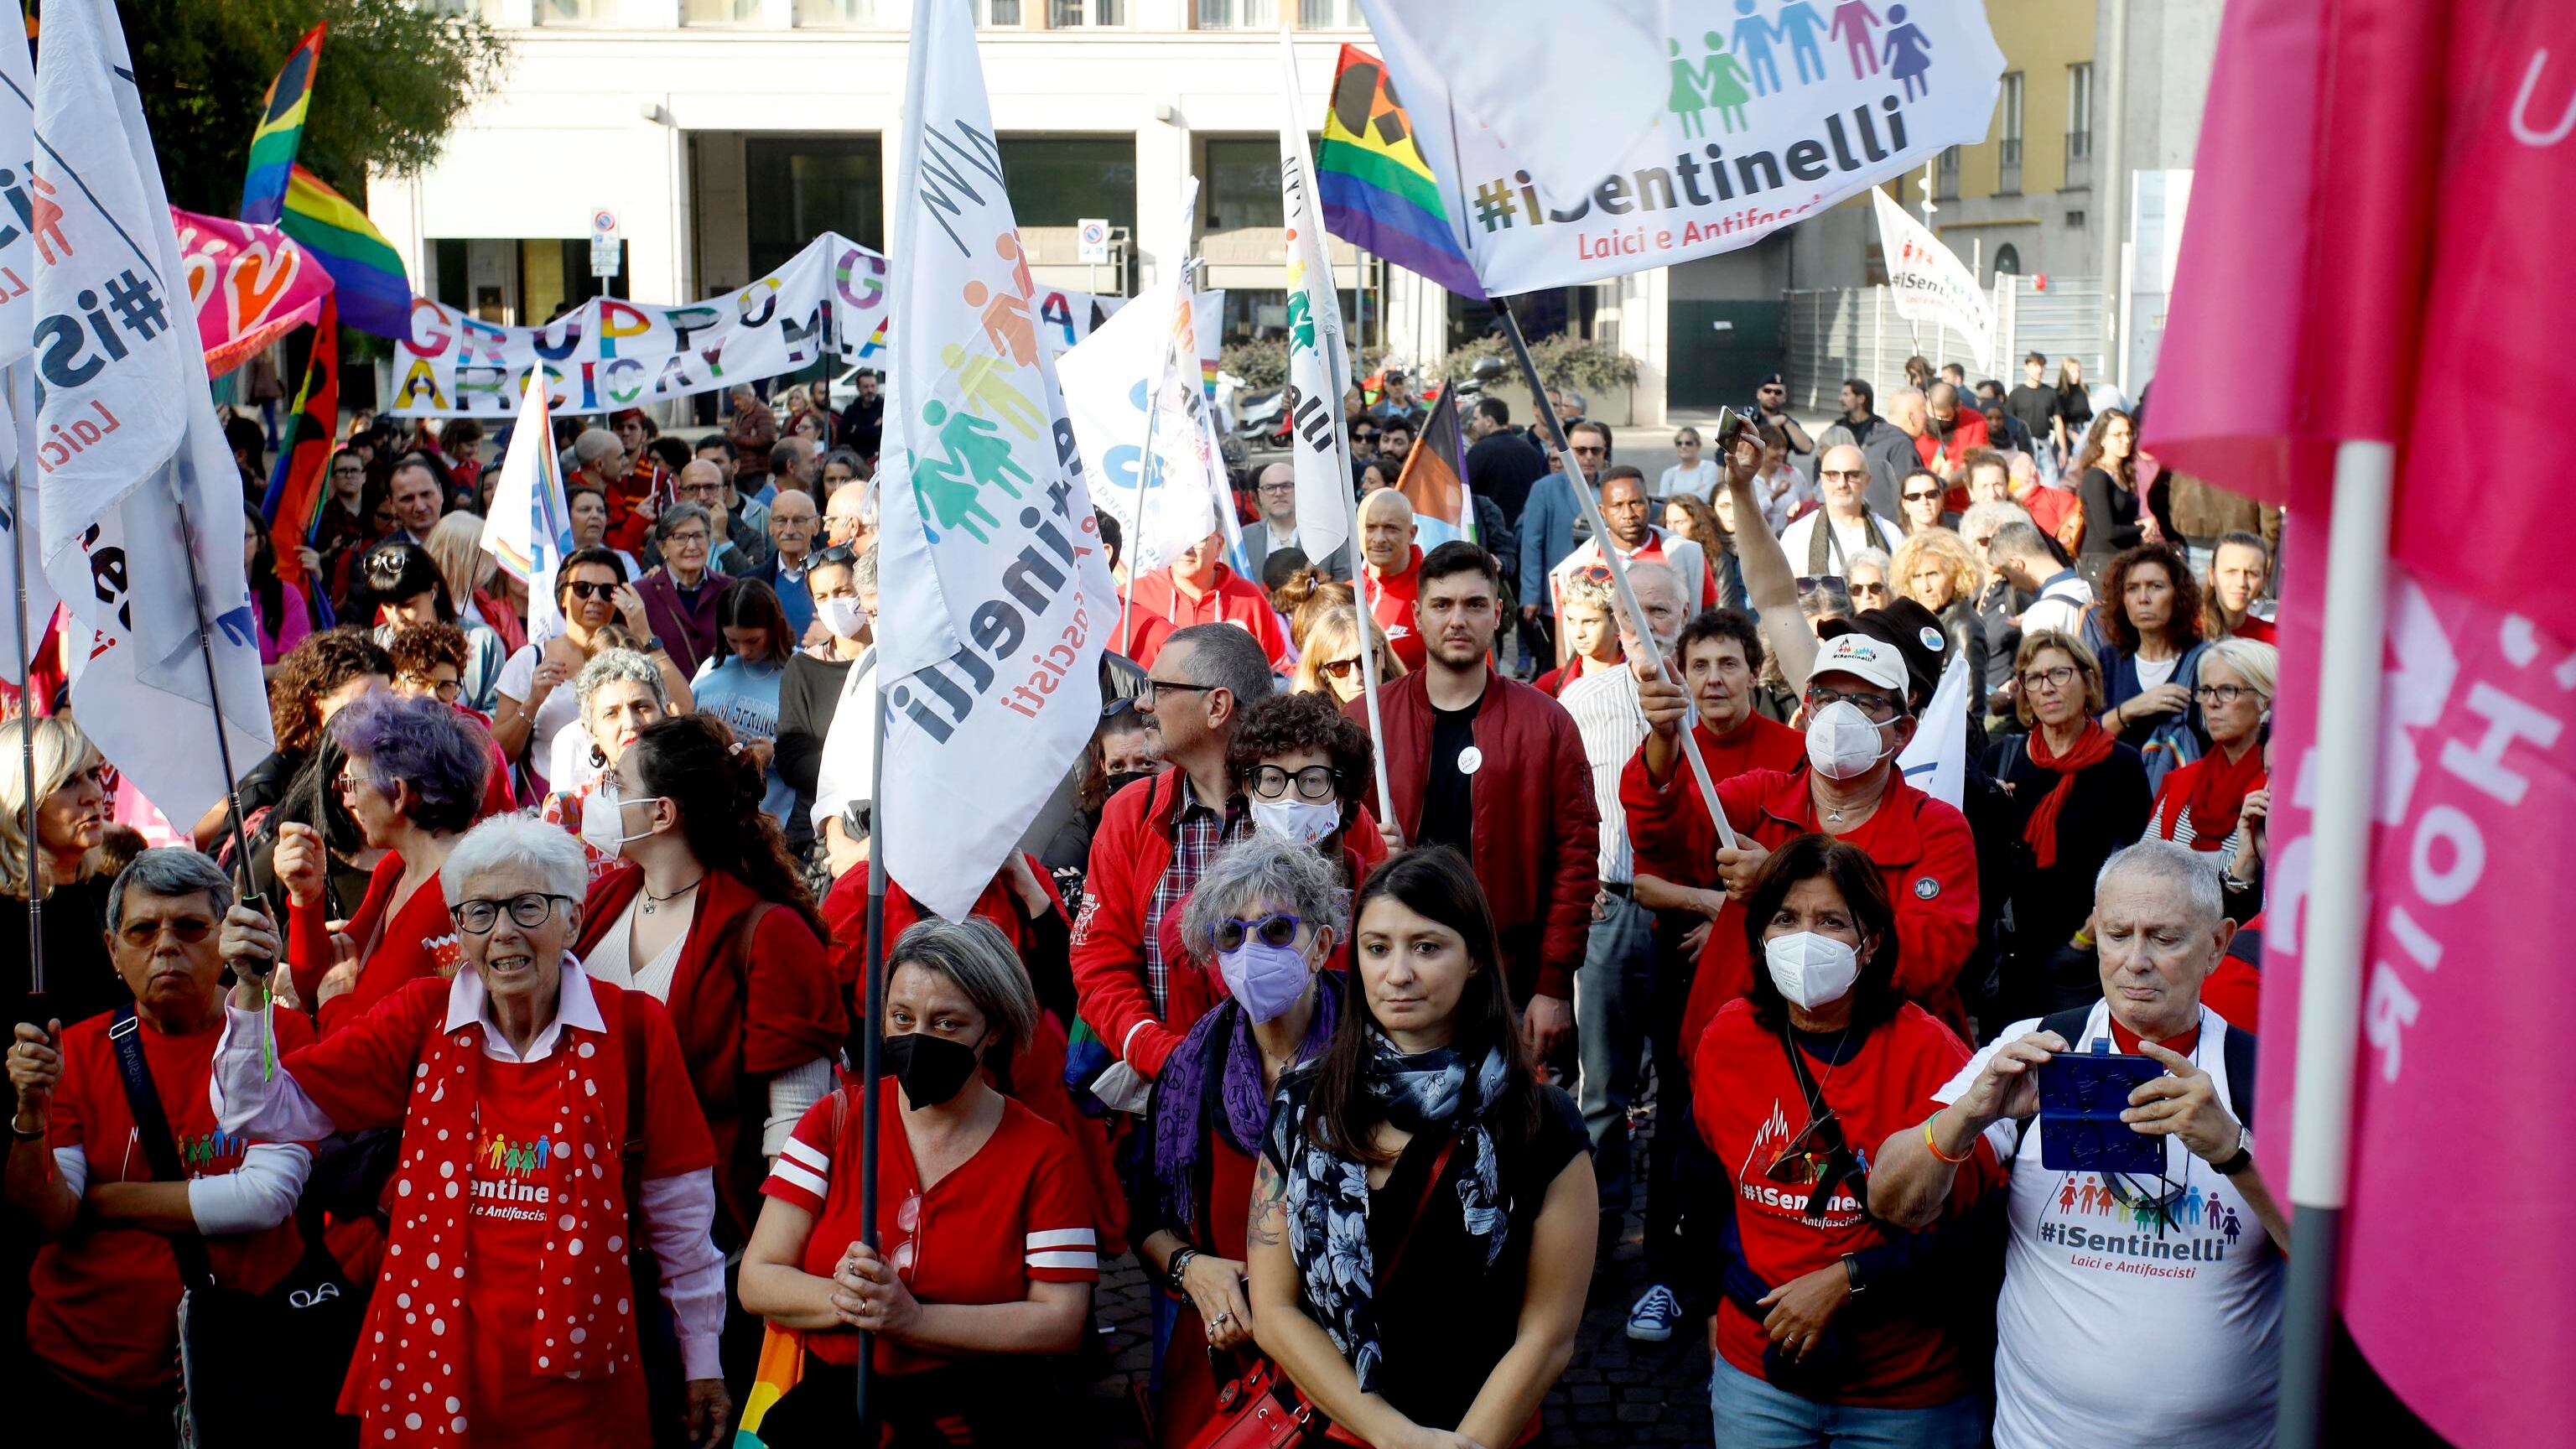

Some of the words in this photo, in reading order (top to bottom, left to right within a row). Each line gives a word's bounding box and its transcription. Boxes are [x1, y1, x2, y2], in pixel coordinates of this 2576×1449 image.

[1473, 95, 1909, 233] #ientinelli
[1578, 226, 1644, 261] Laici
[1655, 229, 1672, 250] e
[401, 277, 782, 361] GRUPPO
[470, 1177, 549, 1203] entine
[2040, 1222, 2225, 1262] #iSentinelli
[2070, 1254, 2101, 1270] Laici
[2105, 1262, 2113, 1271] e
[2116, 1260, 2196, 1279] Antifascisti
